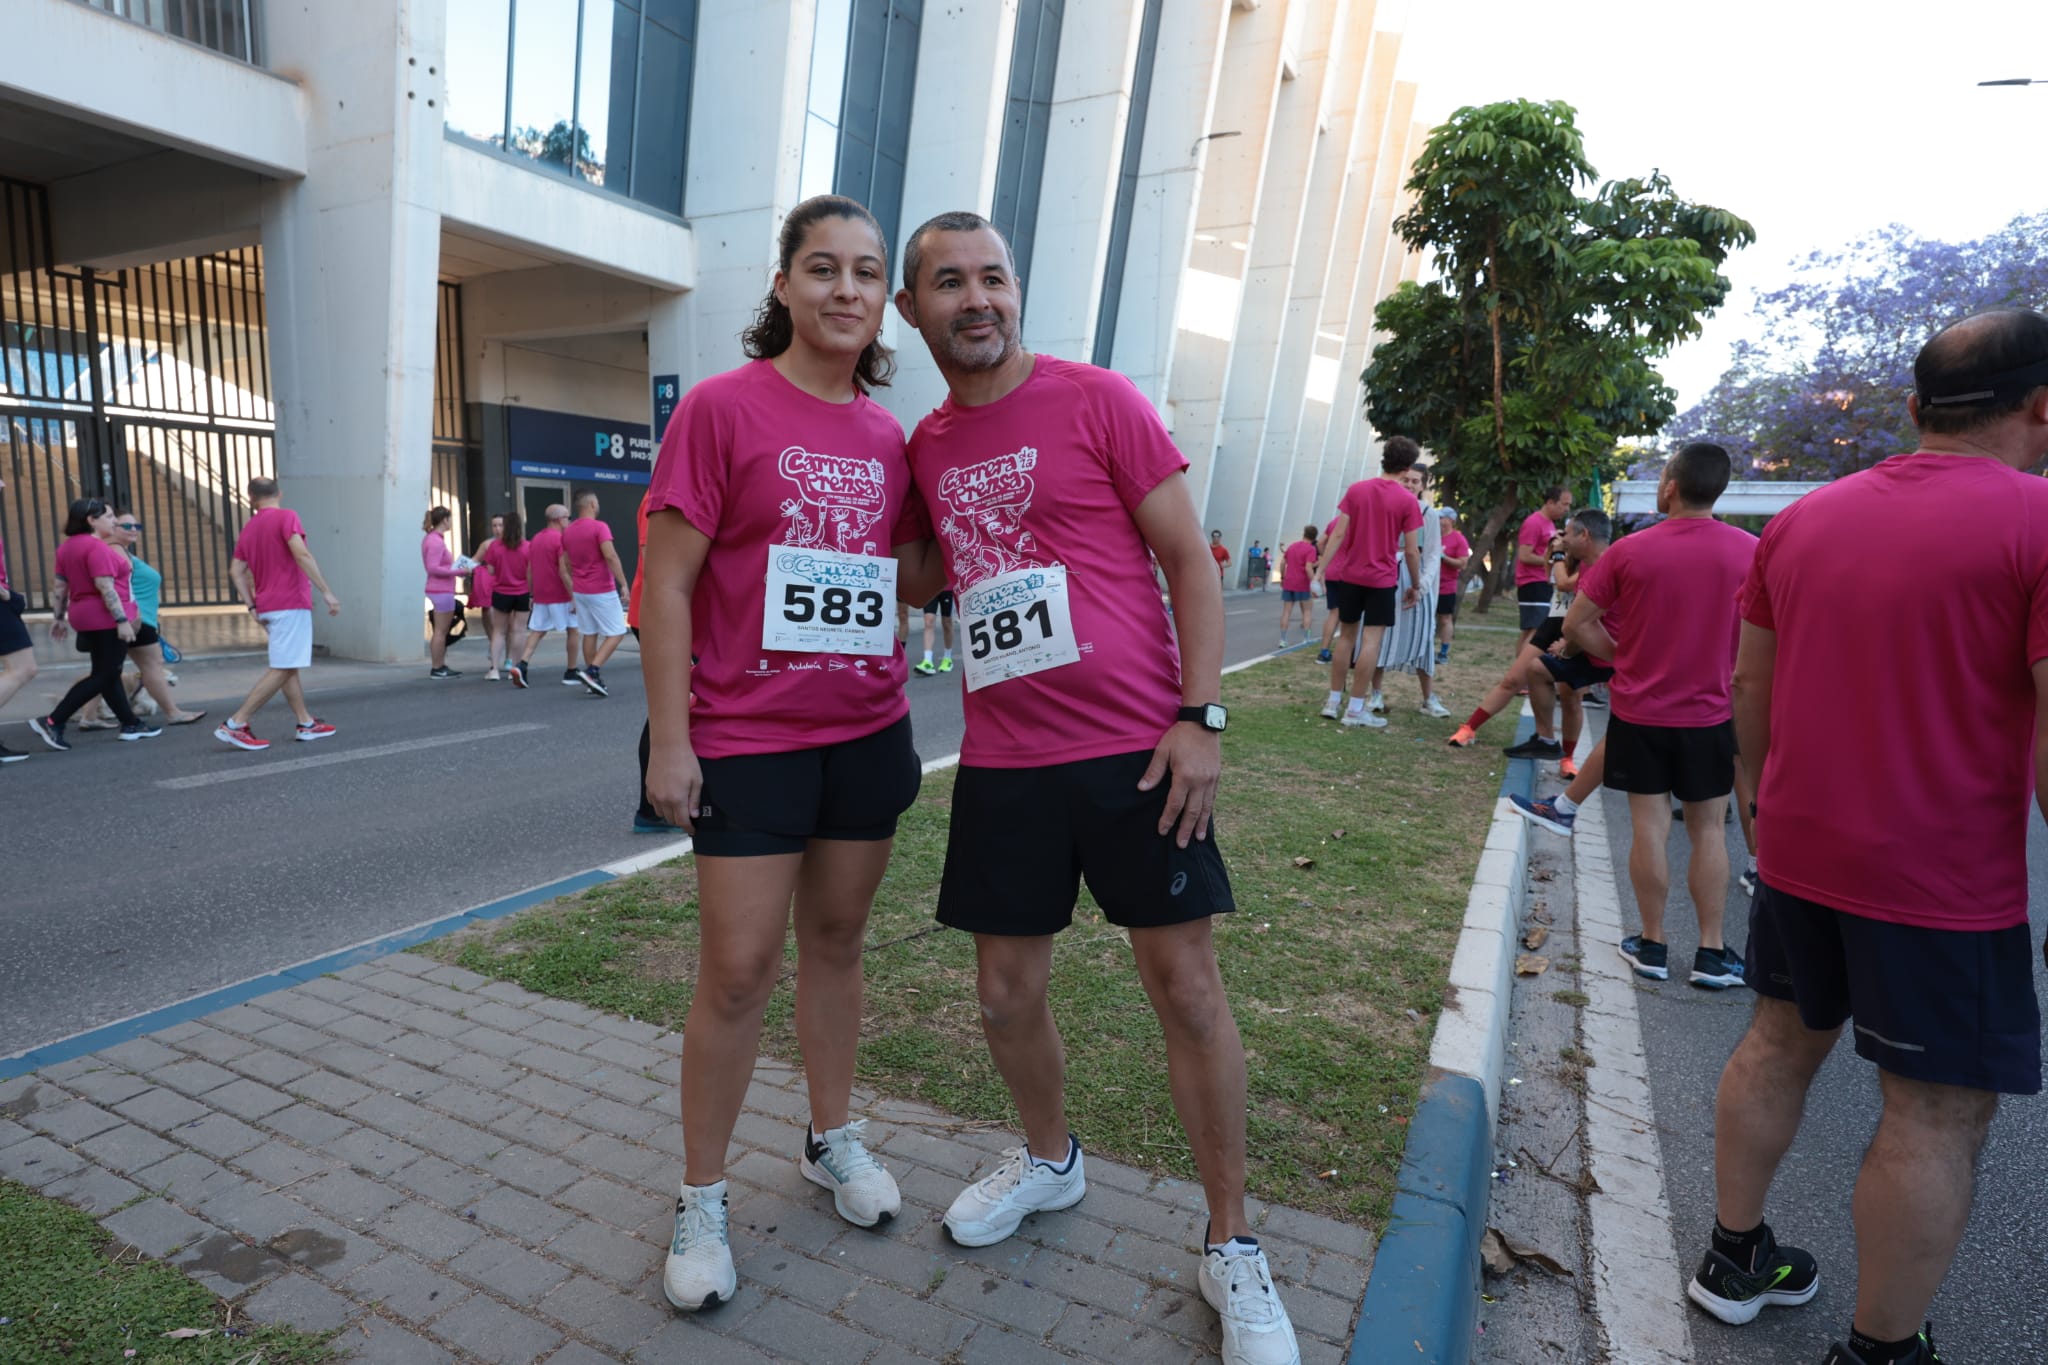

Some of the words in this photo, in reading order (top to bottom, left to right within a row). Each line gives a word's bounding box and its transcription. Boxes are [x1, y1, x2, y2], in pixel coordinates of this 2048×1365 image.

[658, 384, 674, 399] P8
[595, 432, 624, 459] P8
[787, 452, 871, 478] Carrera
[943, 456, 1017, 493] Carrera
[783, 584, 883, 627] 583
[969, 600, 1053, 660] 581
